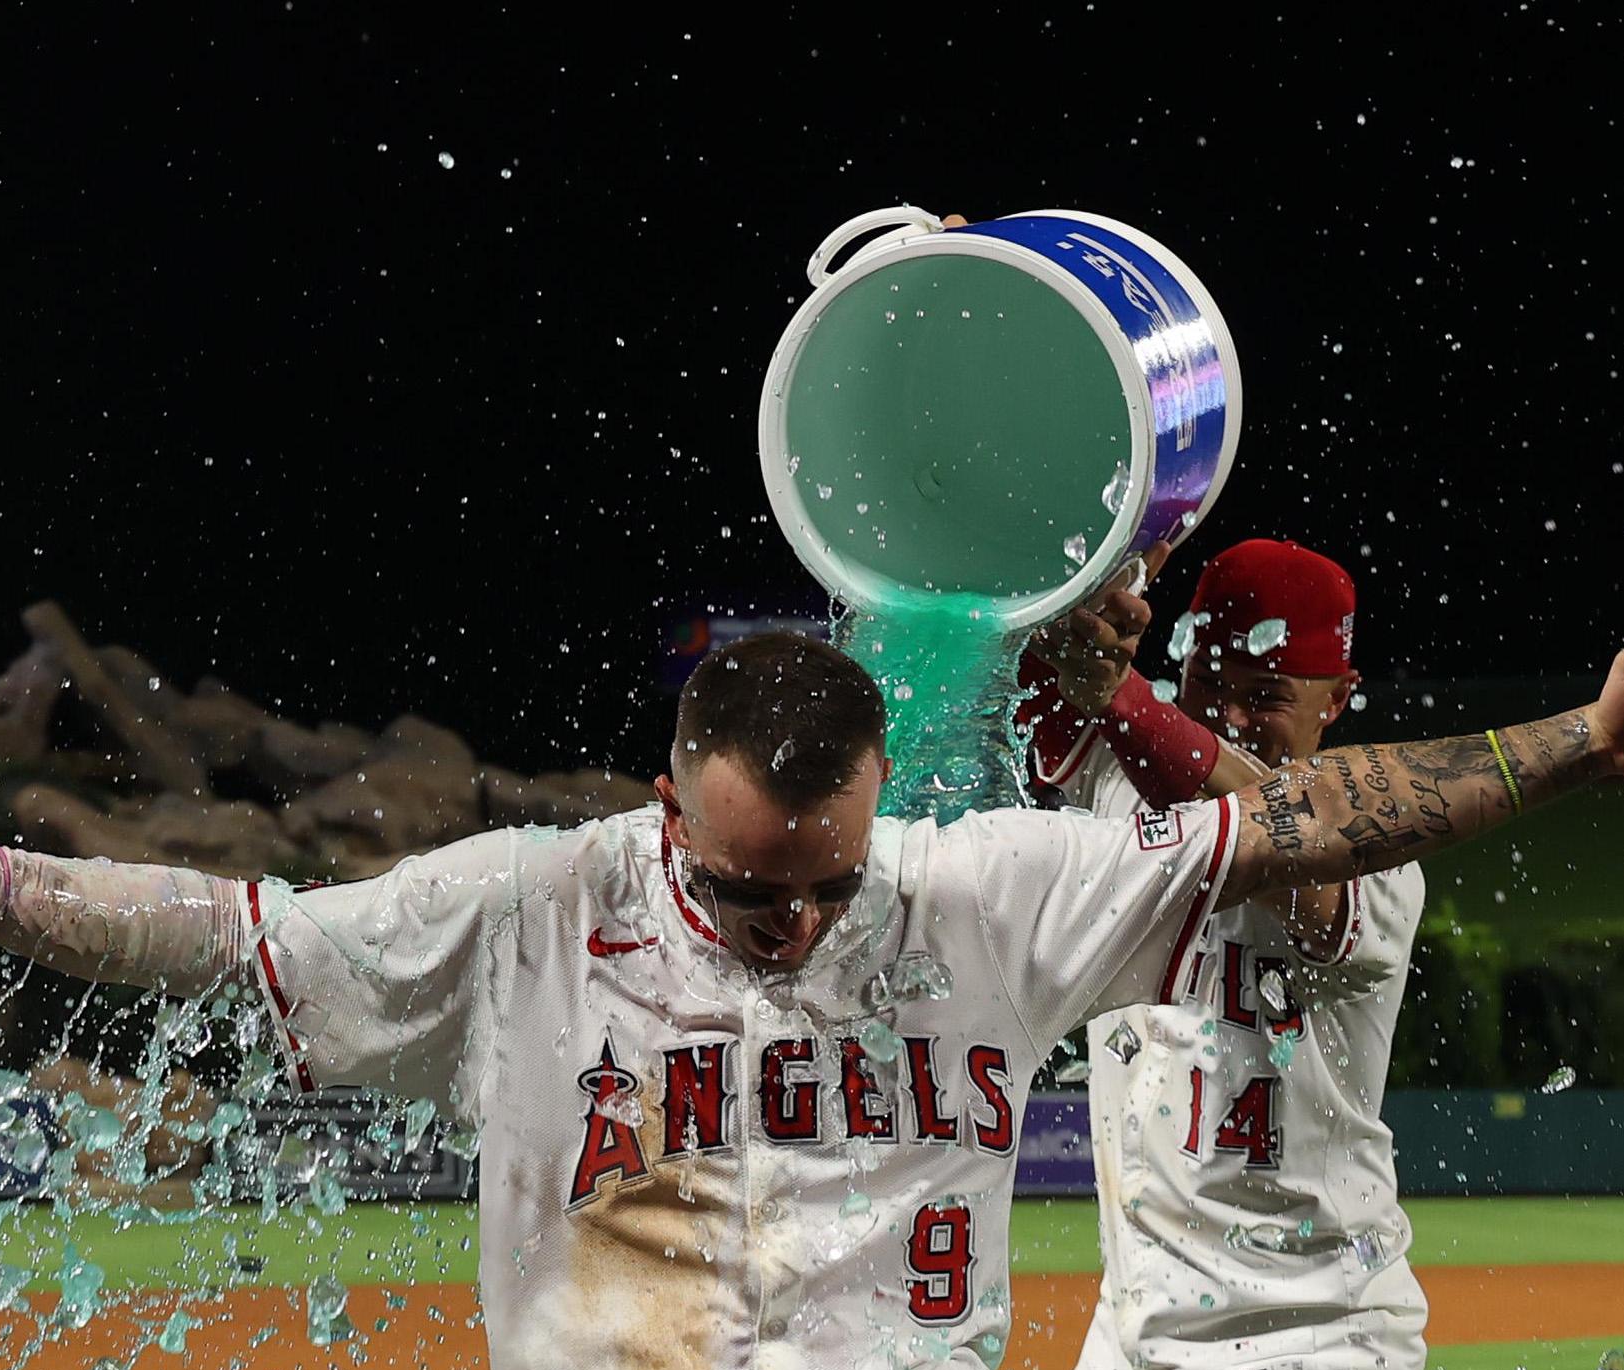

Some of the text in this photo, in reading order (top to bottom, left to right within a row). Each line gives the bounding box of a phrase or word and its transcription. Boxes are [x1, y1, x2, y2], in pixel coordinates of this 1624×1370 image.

[564, 1024, 1016, 1216] ANGELS
[1178, 1064, 1283, 1171] 14
[902, 1196, 979, 1330] 9
